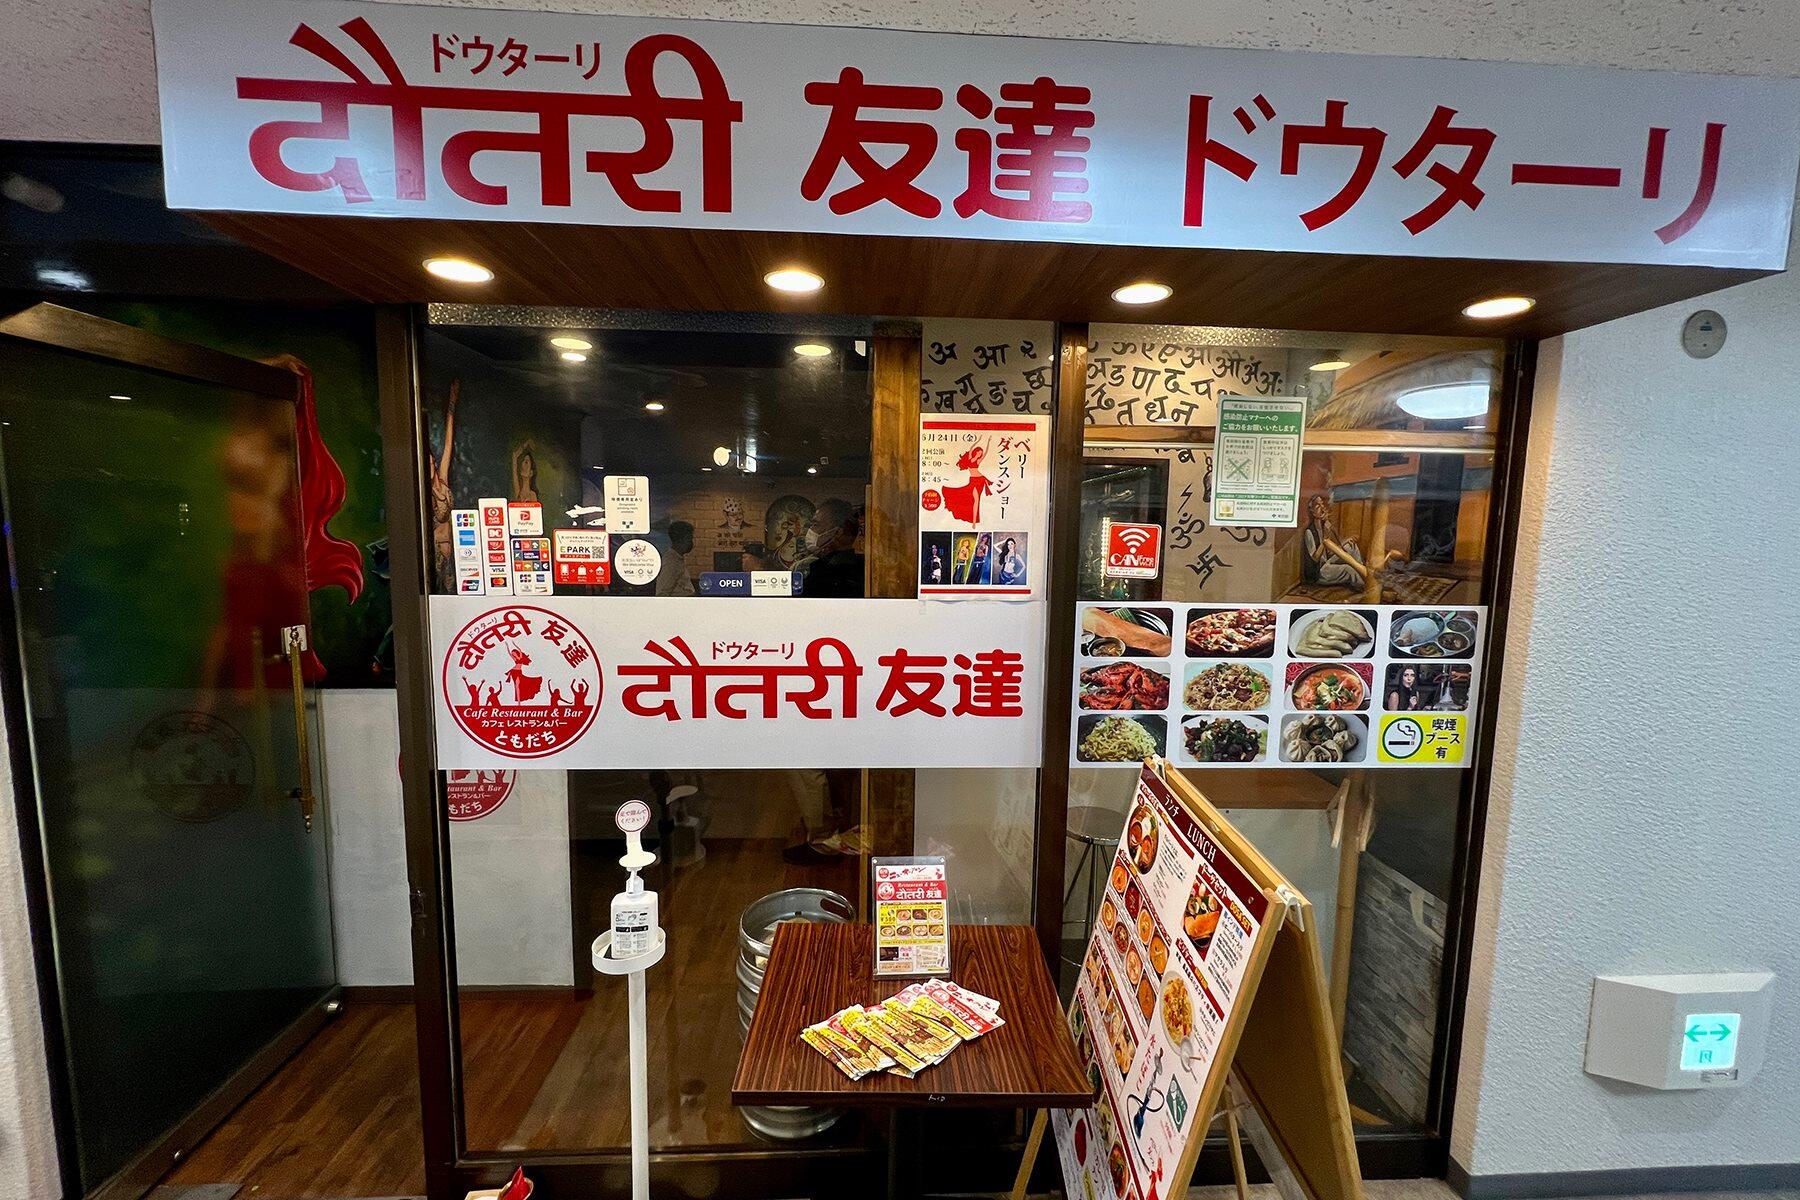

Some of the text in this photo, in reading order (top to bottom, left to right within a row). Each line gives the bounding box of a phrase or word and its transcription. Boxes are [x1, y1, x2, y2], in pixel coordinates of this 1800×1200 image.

[431, 33, 602, 79] ドウターリ
[236, 16, 1728, 245] दौतरी 友達 ドウターリ
[1014, 438, 1031, 479] ベリー
[996, 436, 1013, 519] ダンスショー
[457, 513, 475, 527] JCB
[560, 546, 591, 554] EPARK
[719, 579, 743, 588] OPEN
[467, 616, 499, 639] ドウターリ
[540, 619, 590, 669] 友達
[711, 641, 796, 660] ドウターリ
[617, 635, 1024, 721] दौतरी 友達
[463, 707, 583, 719] Cafe Restaurant & Bar
[481, 719, 567, 727] カフェ レストラン&バー
[1432, 718, 1457, 731] 喫煙
[494, 730, 556, 748] ともだち
[1426, 733, 1460, 745] ブース
[1435, 746, 1448, 759] 有
[487, 784, 502, 792] Bar
[448, 801, 482, 814] もだち
[1164, 794, 1180, 817] ランチ
[1187, 822, 1217, 863] LUNCH
